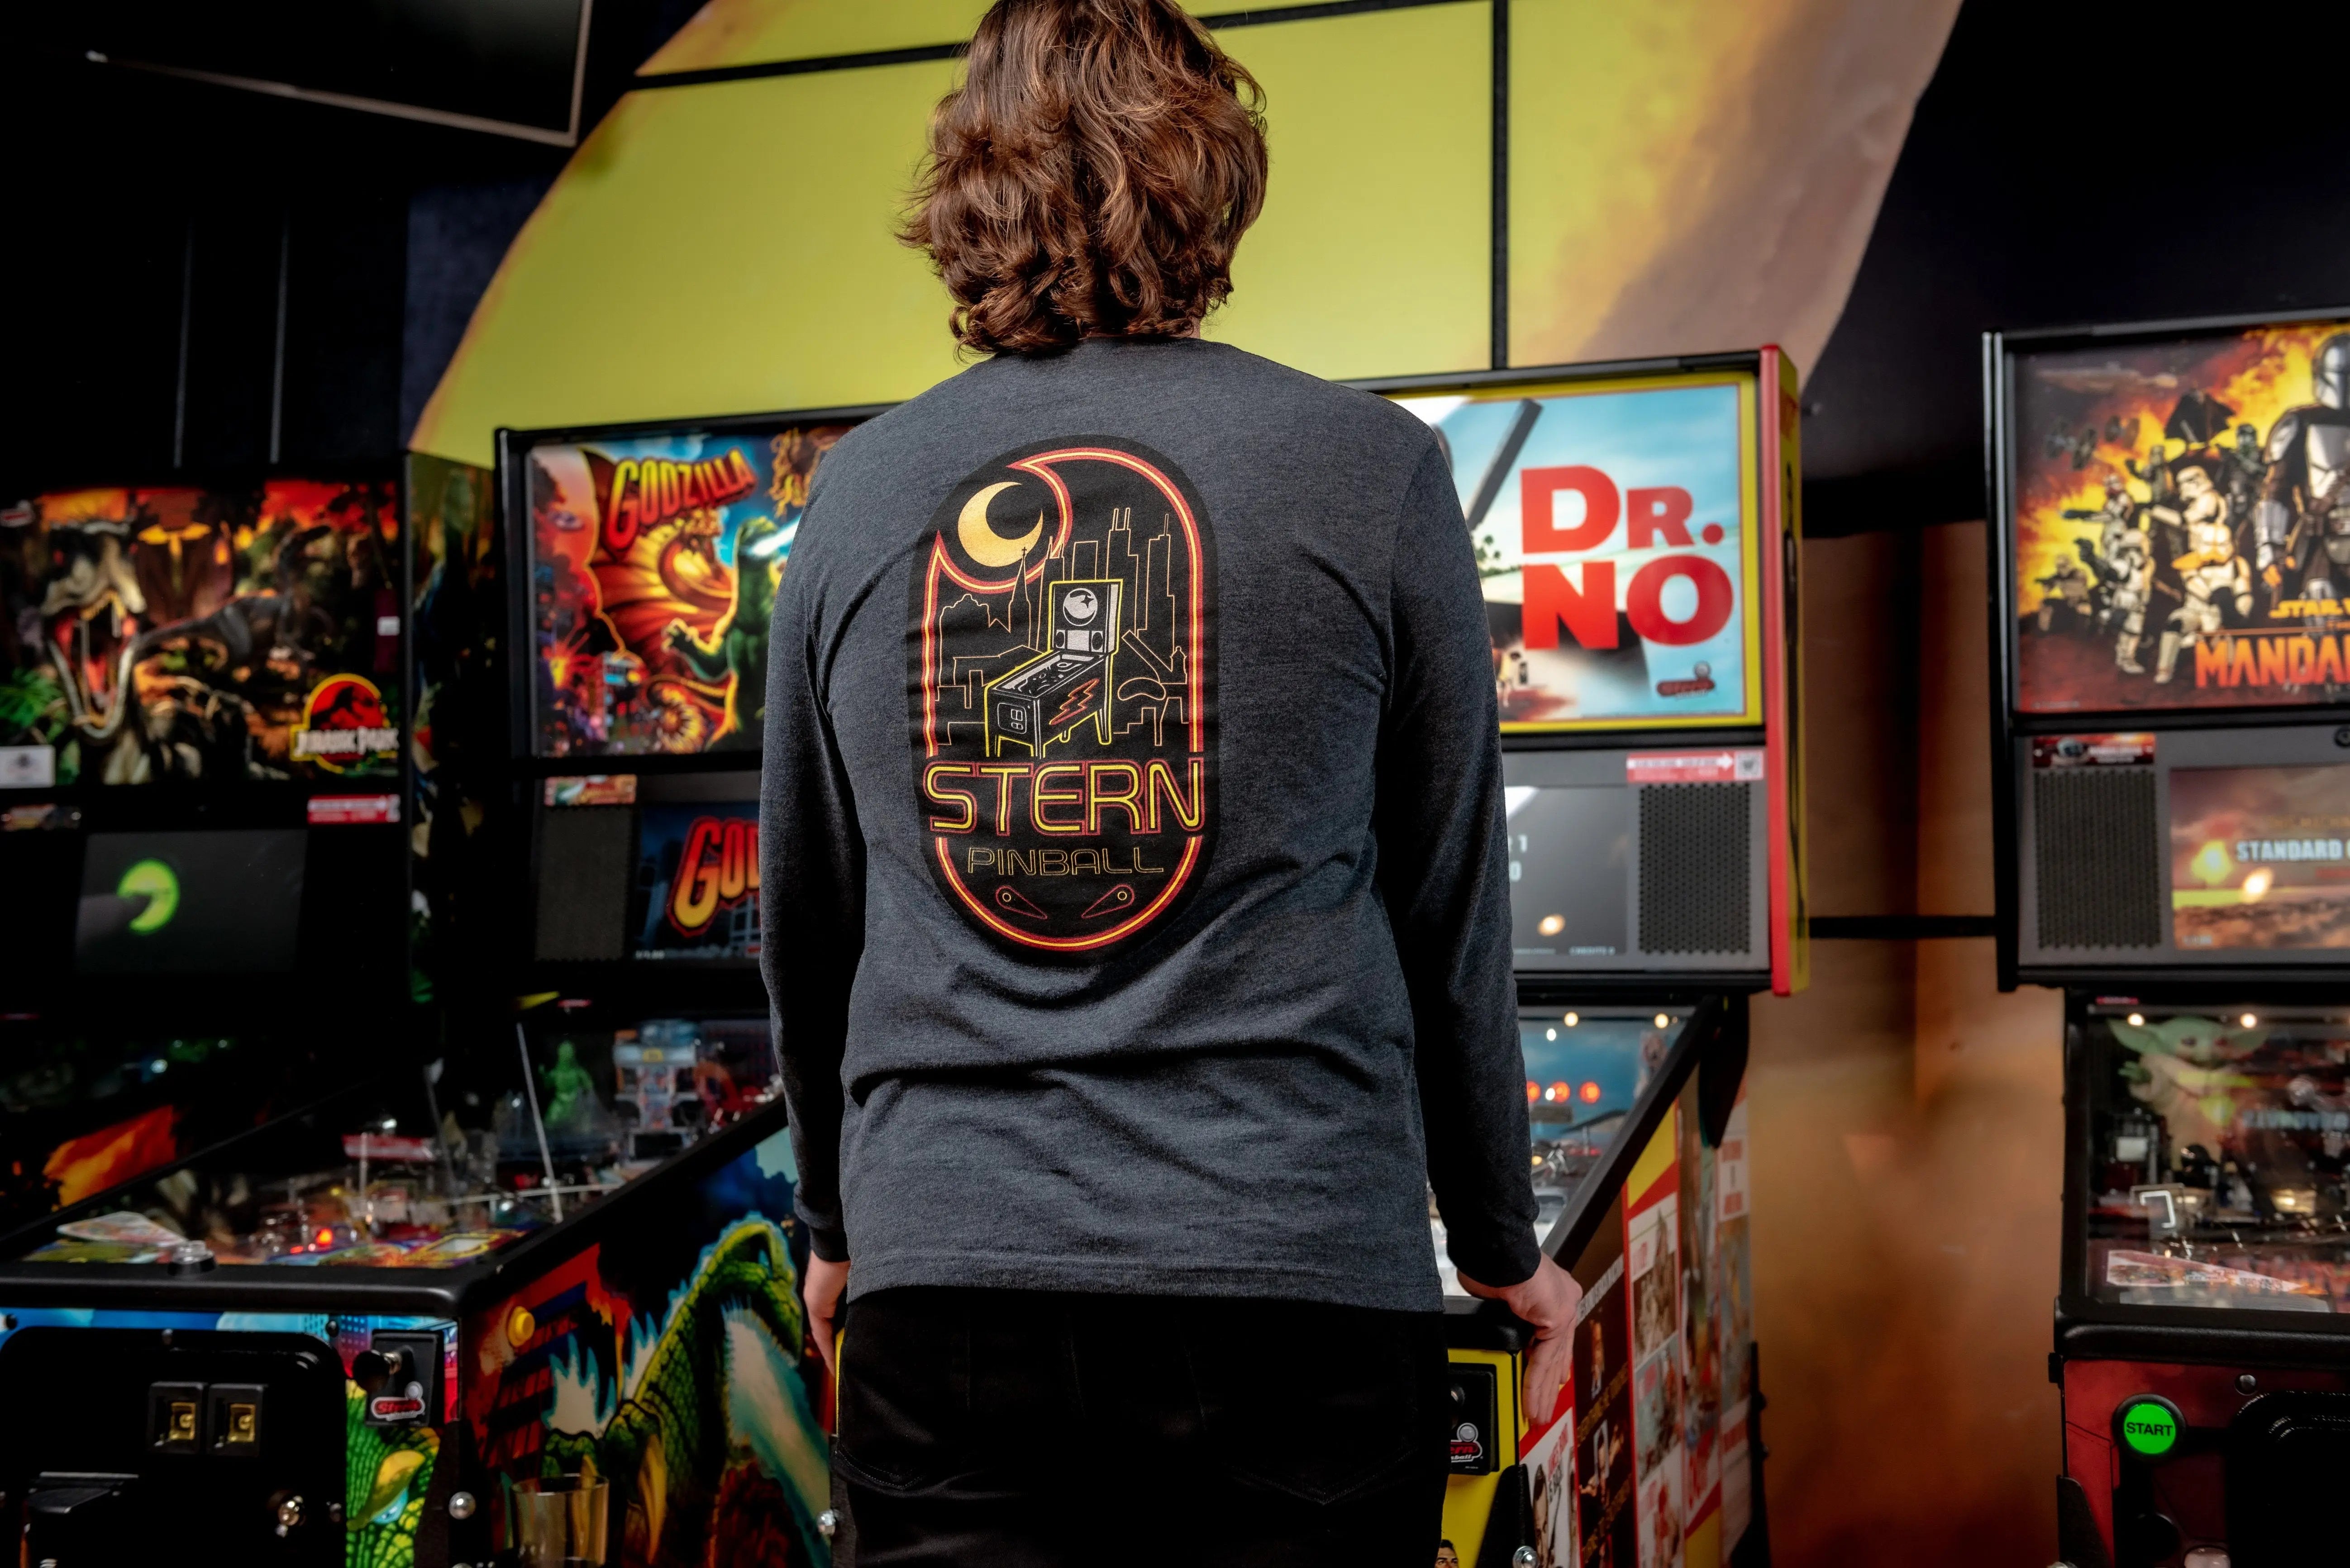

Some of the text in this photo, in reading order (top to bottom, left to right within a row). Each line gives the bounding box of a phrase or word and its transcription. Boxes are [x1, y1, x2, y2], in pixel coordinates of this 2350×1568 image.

[605, 448, 757, 550] GODZILLA
[1521, 554, 1734, 651] NO
[2195, 633, 2350, 688] MANDA
[923, 757, 1205, 837] STERN
[968, 847, 1163, 876] PINBALL
[2236, 838, 2343, 862] STANDARD
[2126, 1421, 2173, 1437] START
